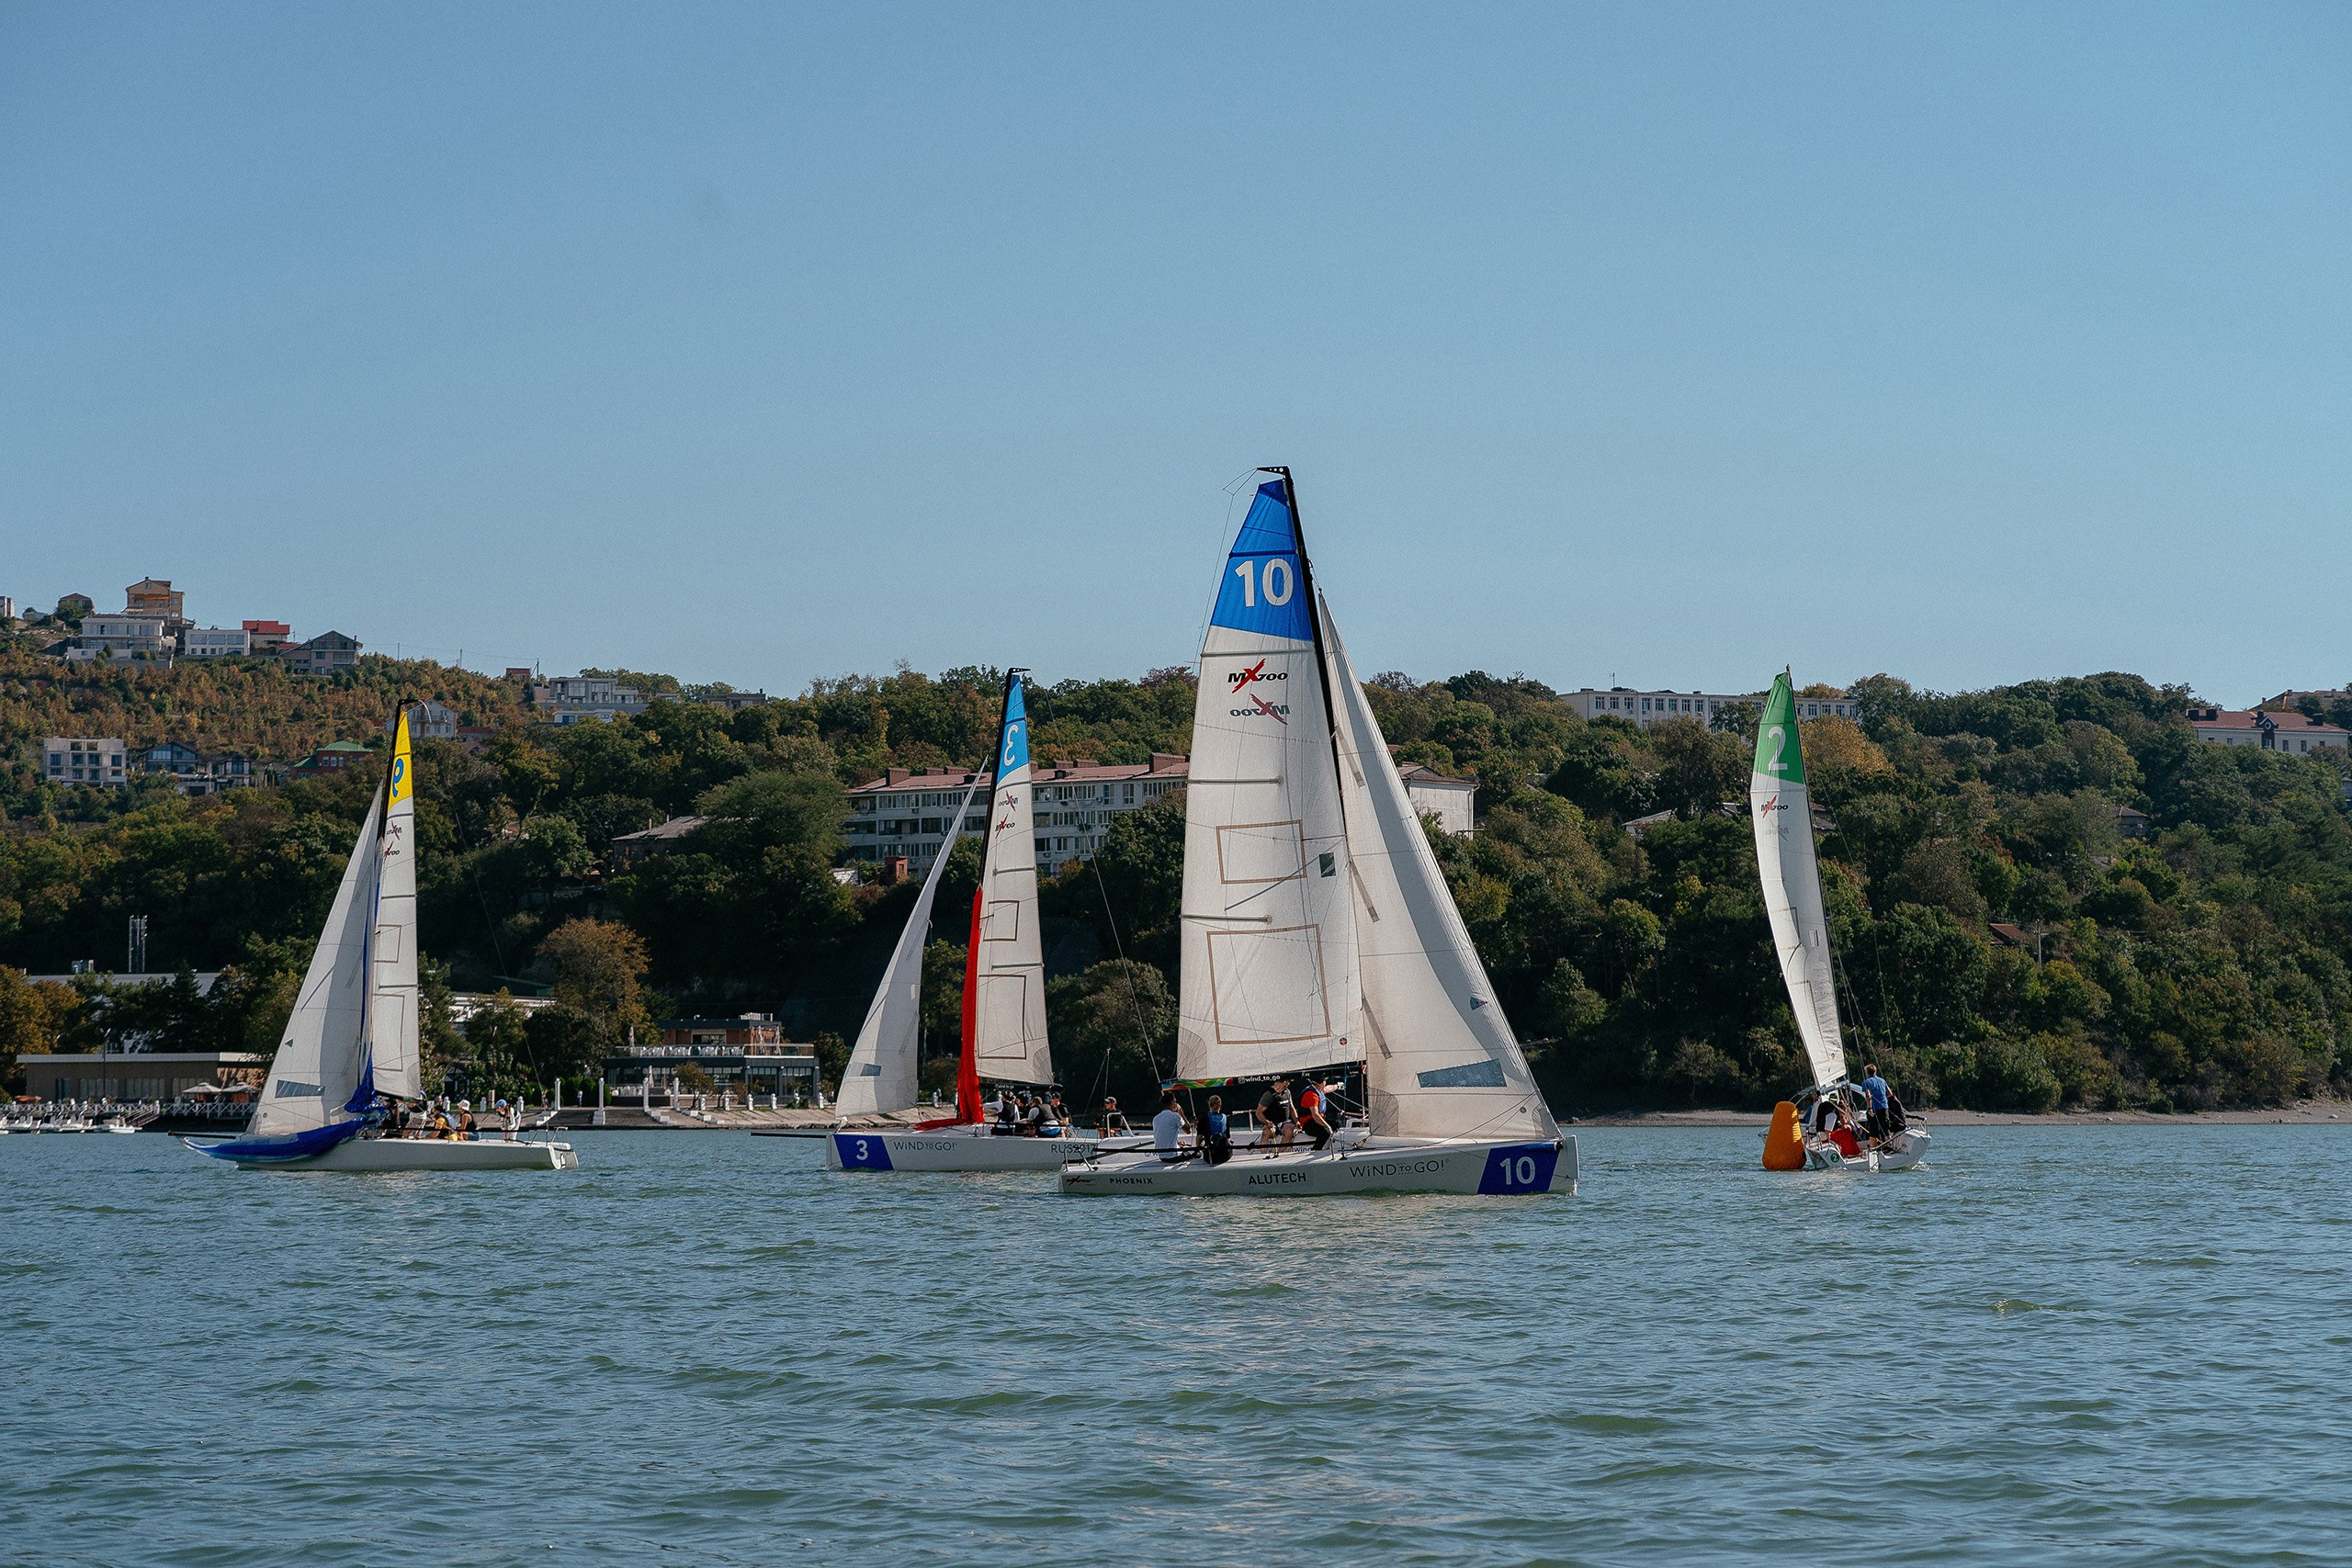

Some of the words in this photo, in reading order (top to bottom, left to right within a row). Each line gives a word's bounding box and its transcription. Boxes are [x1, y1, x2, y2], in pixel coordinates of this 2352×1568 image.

[1234, 558, 1294, 607] 10
[1227, 658, 1288, 694] MX700
[1768, 726, 1788, 771] 2
[856, 1140, 868, 1160] 3
[1249, 1172, 1306, 1185] ALUTECH
[1499, 1156, 1536, 1185] 10
